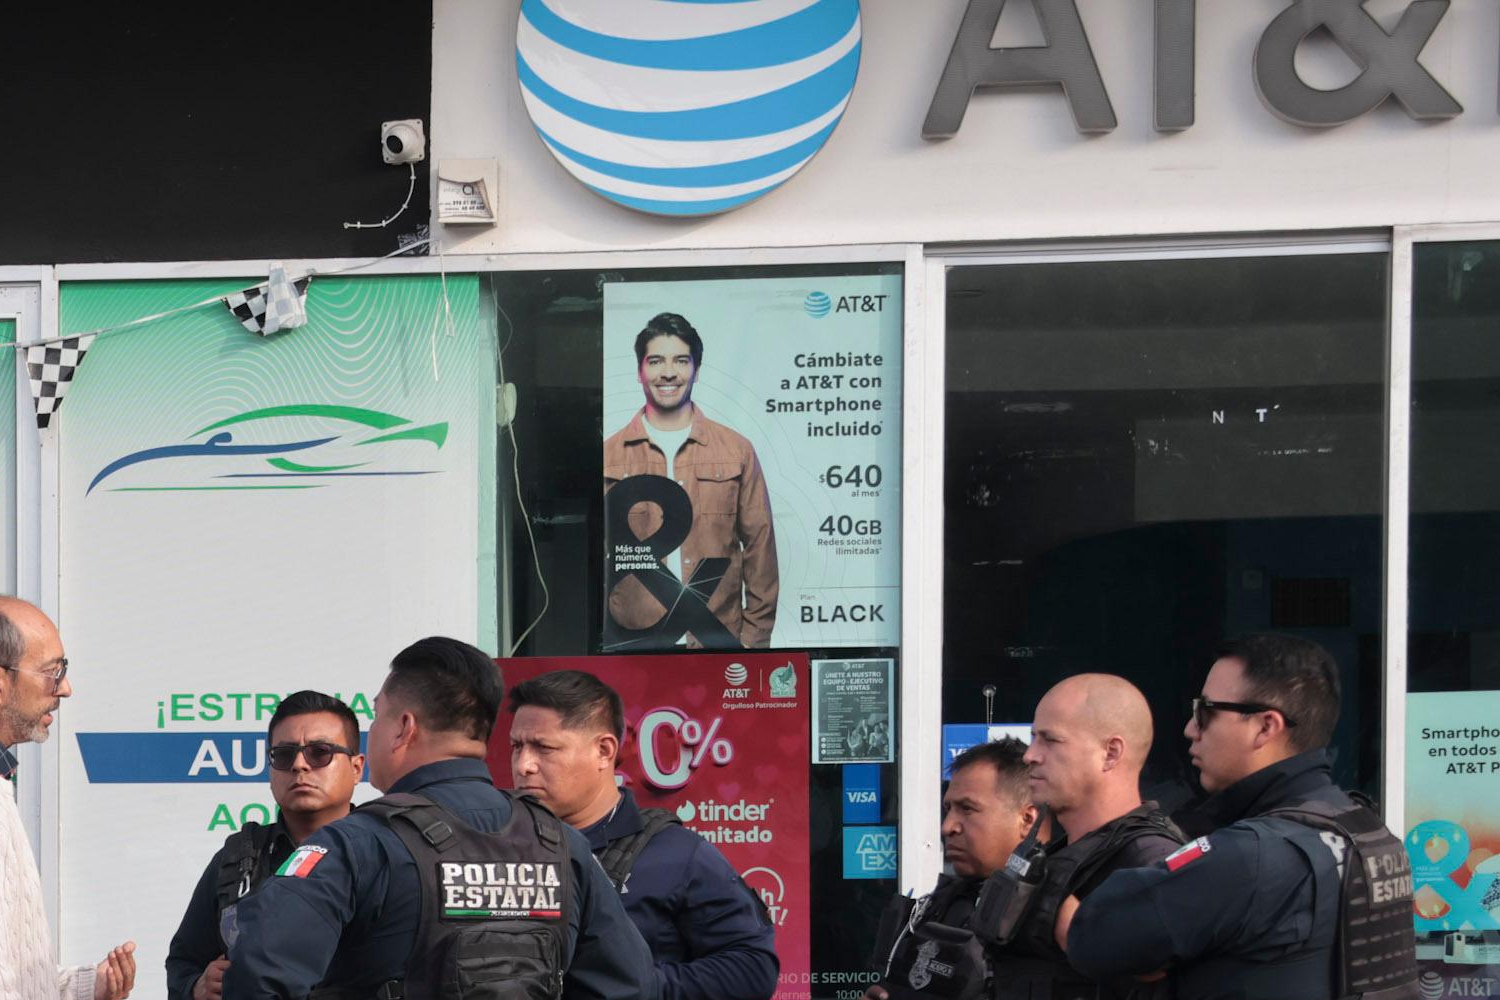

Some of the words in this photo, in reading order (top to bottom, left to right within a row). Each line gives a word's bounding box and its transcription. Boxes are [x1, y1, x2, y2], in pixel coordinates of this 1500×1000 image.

[836, 295, 886, 313] AT&T
[794, 352, 883, 369] Cámbiate
[780, 379, 790, 390] a
[796, 375, 844, 390] AT&T
[849, 378, 882, 389] con
[765, 399, 882, 415] Smartphone
[819, 464, 882, 488] $640
[851, 490, 860, 498] al
[819, 515, 882, 536] 40GB
[615, 544, 633, 553] Más
[634, 546, 651, 554] que
[818, 538, 844, 546] Redes
[847, 537, 882, 546] sociales
[615, 553, 656, 561] números,
[615, 562, 659, 572] personas.
[800, 604, 884, 623] BLACK
[722, 688, 749, 698] AT&T
[157, 693, 376, 728] ¡ESTRA
[722, 702, 754, 710] Orgulloso
[616, 711, 732, 786] 0%
[1429, 747, 1447, 757] en
[1452, 744, 1497, 756] todos
[188, 740, 266, 777] AU
[1446, 762, 1486, 774] AT&T
[846, 791, 877, 803] VISA
[698, 799, 769, 821] tinder
[685, 825, 772, 843] mitado
[442, 862, 560, 886] POLICIA
[444, 886, 560, 909] ESTATAL
[1372, 875, 1414, 904] ESTAT
[801, 972, 818, 984] DE
[821, 971, 880, 983] SERVICIO
[1448, 978, 1494, 997] AT&T
